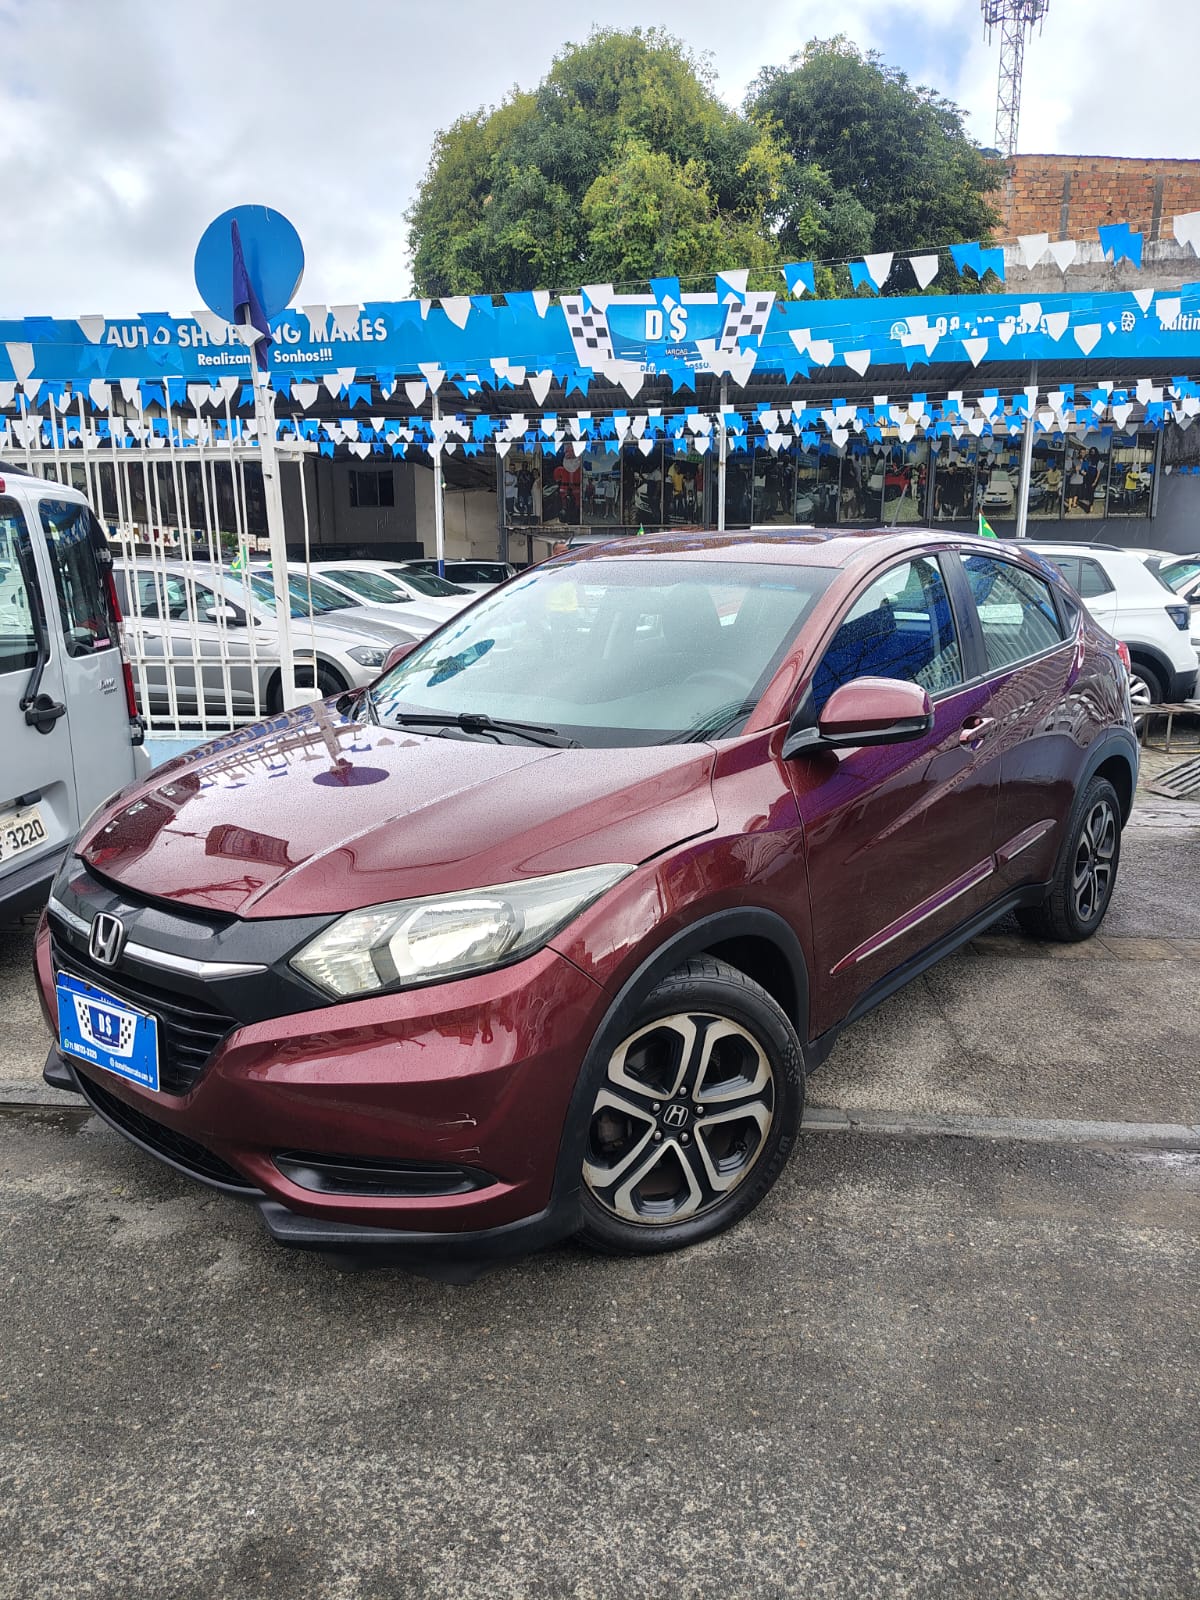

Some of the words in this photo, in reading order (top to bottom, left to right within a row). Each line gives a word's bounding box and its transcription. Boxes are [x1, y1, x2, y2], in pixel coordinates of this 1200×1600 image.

[107, 326, 170, 348] AUTO
[309, 318, 387, 343] MARES
[274, 348, 333, 362] Sonhos!!!
